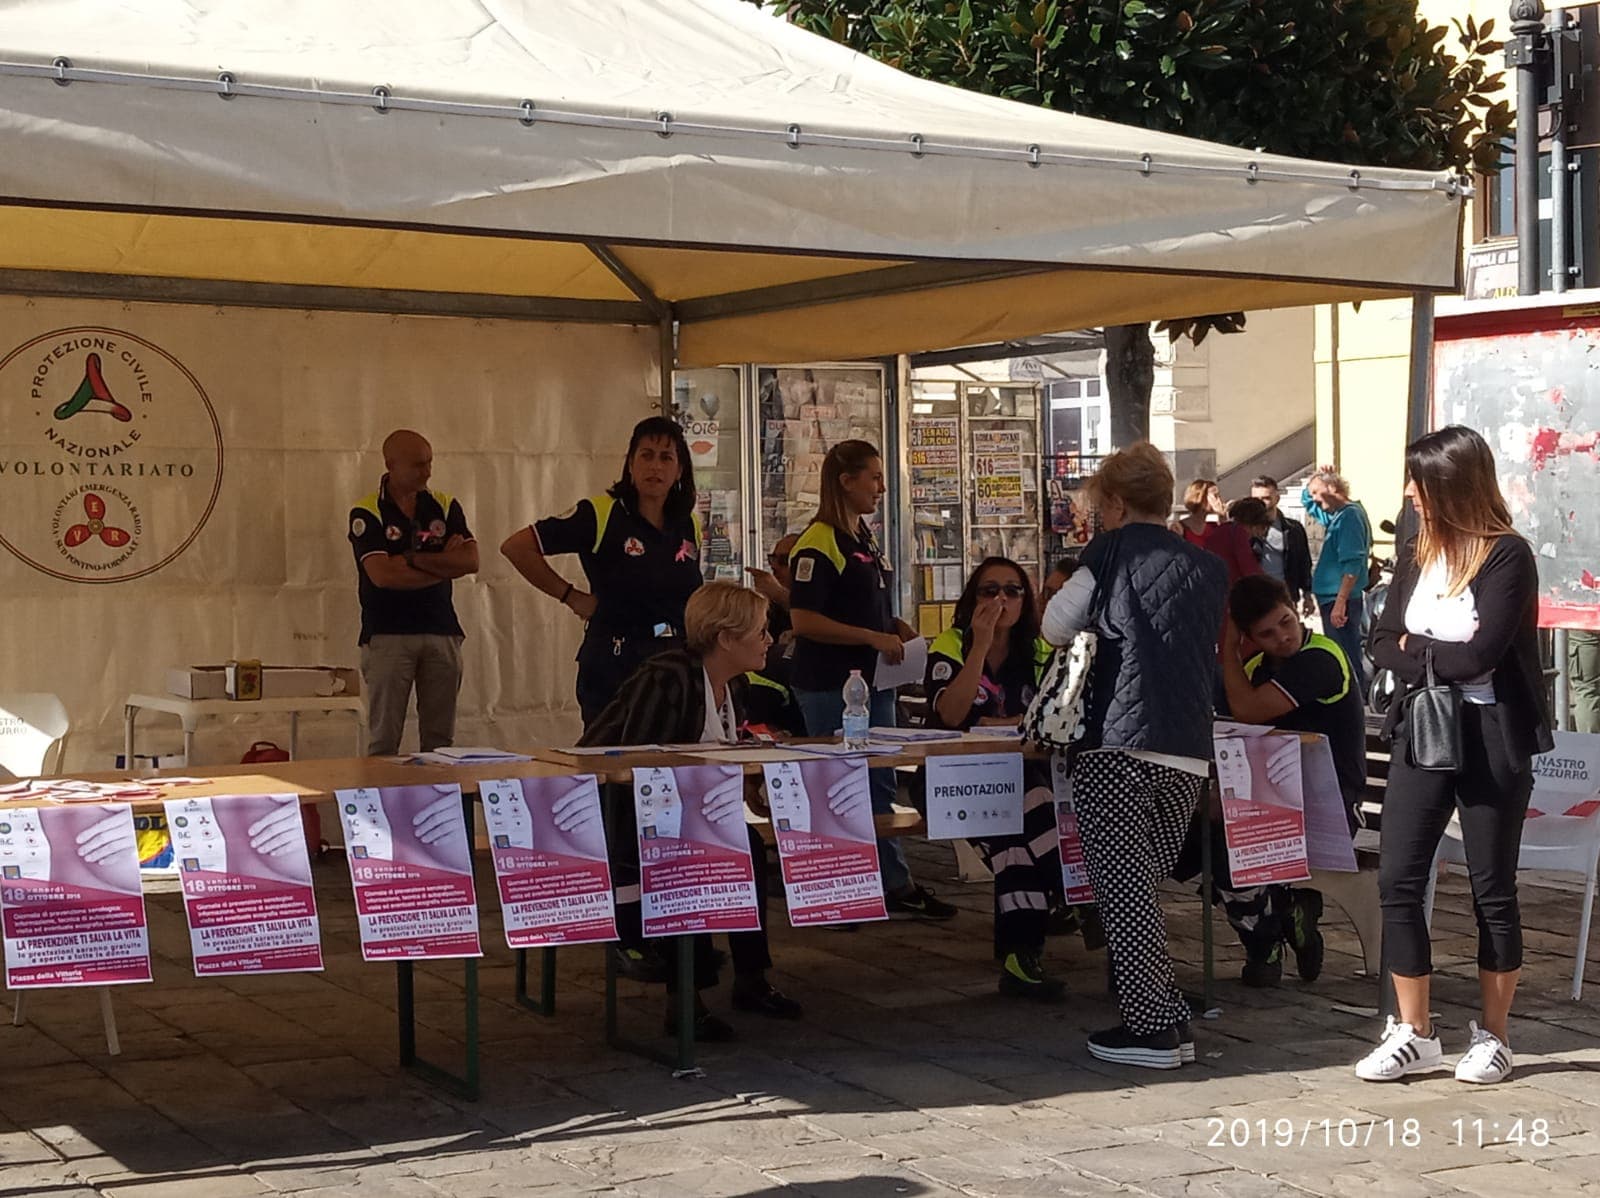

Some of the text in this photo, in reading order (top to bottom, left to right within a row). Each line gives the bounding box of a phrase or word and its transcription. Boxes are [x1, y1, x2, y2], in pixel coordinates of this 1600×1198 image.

[31, 338, 152, 403] PROTEZIONE CIVILE
[44, 429, 141, 458] NAZIONALE
[0, 461, 194, 477] VOLONTARIATO
[976, 458, 994, 476] 616
[978, 484, 992, 498] 60
[74, 530, 81, 540] V
[112, 530, 118, 540] R
[1536, 756, 1586, 770] NASTRO
[1532, 768, 1588, 780] AZZURRO
[934, 782, 1015, 798] PRENOTAZIONI
[498, 856, 515, 869] 18
[355, 867, 373, 880] 18
[186, 880, 206, 892] 18
[4, 889, 25, 902] 18
[369, 917, 376, 926] LA
[201, 919, 312, 939] LA PREVENZIONE TI SALVA LA VITA
[17, 930, 141, 950] LA PREVENZIONE TI SALVA LA VITA
